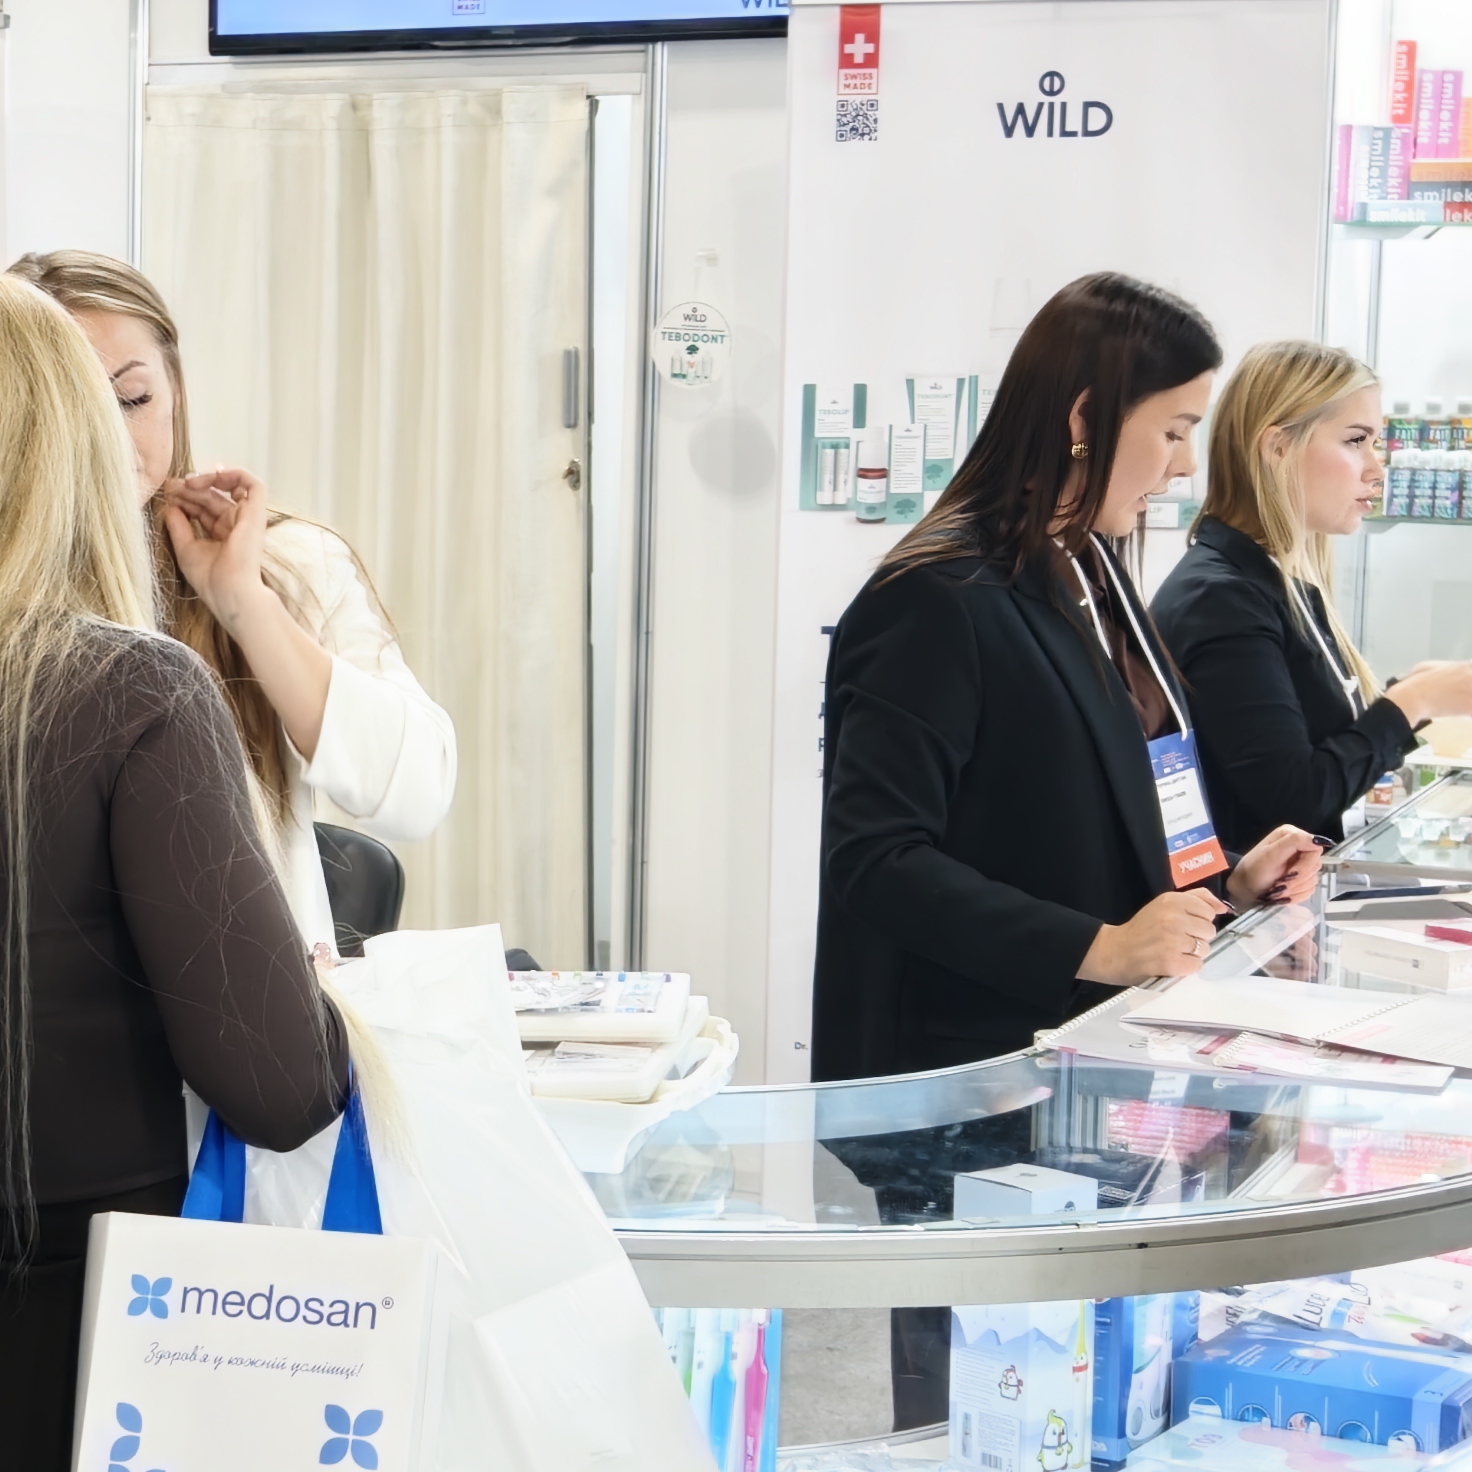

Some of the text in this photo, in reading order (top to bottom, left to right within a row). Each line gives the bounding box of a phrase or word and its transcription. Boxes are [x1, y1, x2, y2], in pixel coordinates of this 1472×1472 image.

[844, 73, 873, 81] SWISS
[843, 82, 873, 90] MADE
[996, 101, 1113, 139] WILD
[683, 313, 708, 323] WILD
[661, 331, 725, 344] TEBODONT
[144, 1341, 364, 1379] Здоров'я у кожній усмішці!
